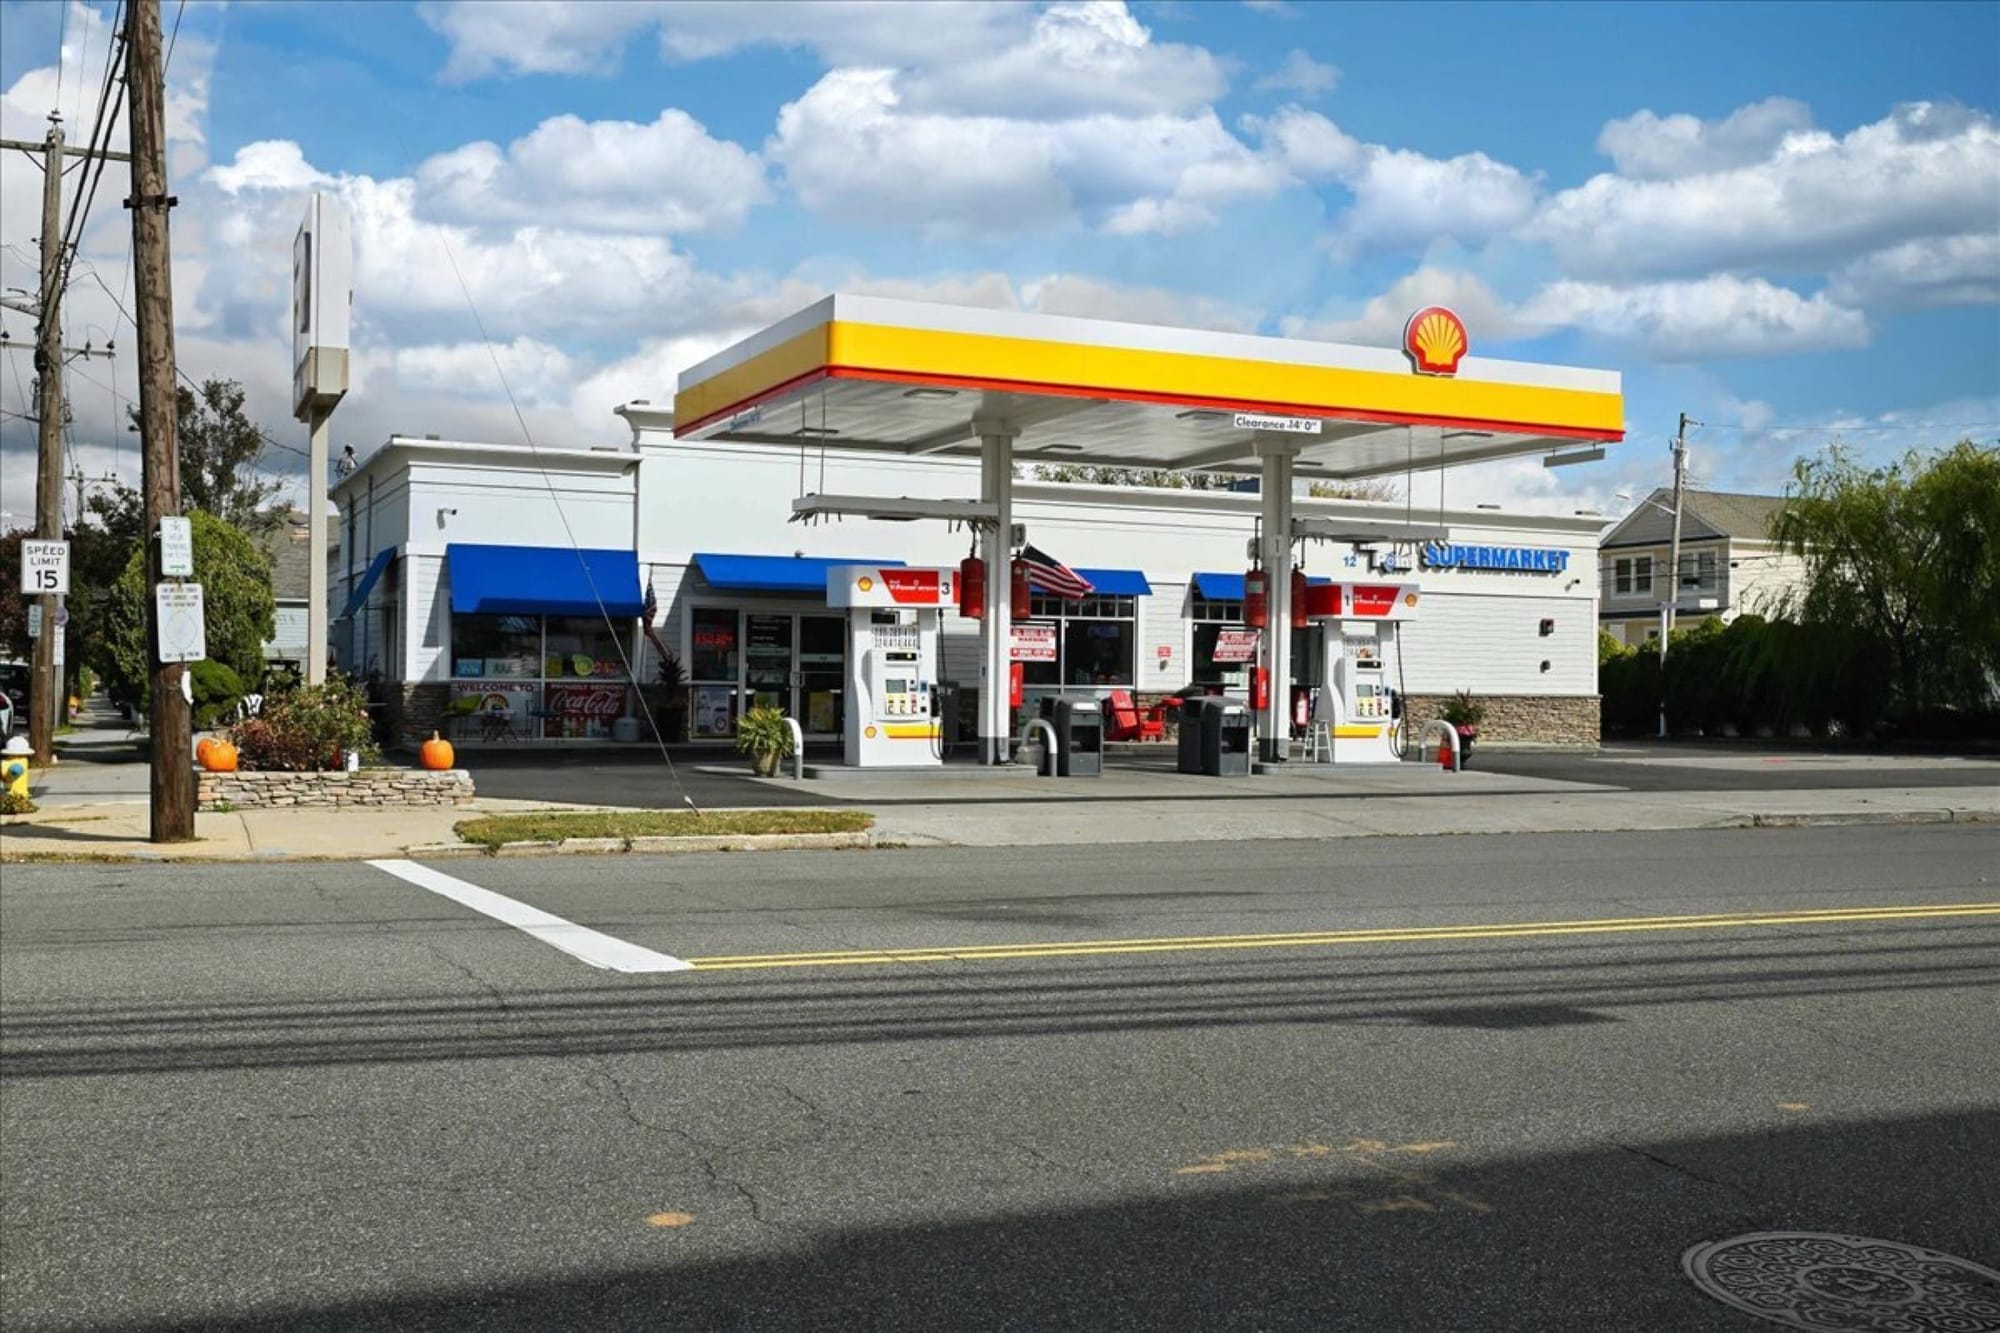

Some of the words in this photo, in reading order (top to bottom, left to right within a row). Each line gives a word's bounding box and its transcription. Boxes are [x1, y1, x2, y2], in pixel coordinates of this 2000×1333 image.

[1236, 416, 1285, 429] Clearance
[27, 545, 65, 556] SPEED
[1425, 543, 1570, 571] SUPERMARKET
[30, 557, 60, 566] LIMIT
[36, 569, 58, 589] 15
[941, 582, 951, 595] 3
[457, 683, 514, 692] WELCOME
[519, 683, 534, 693] TO
